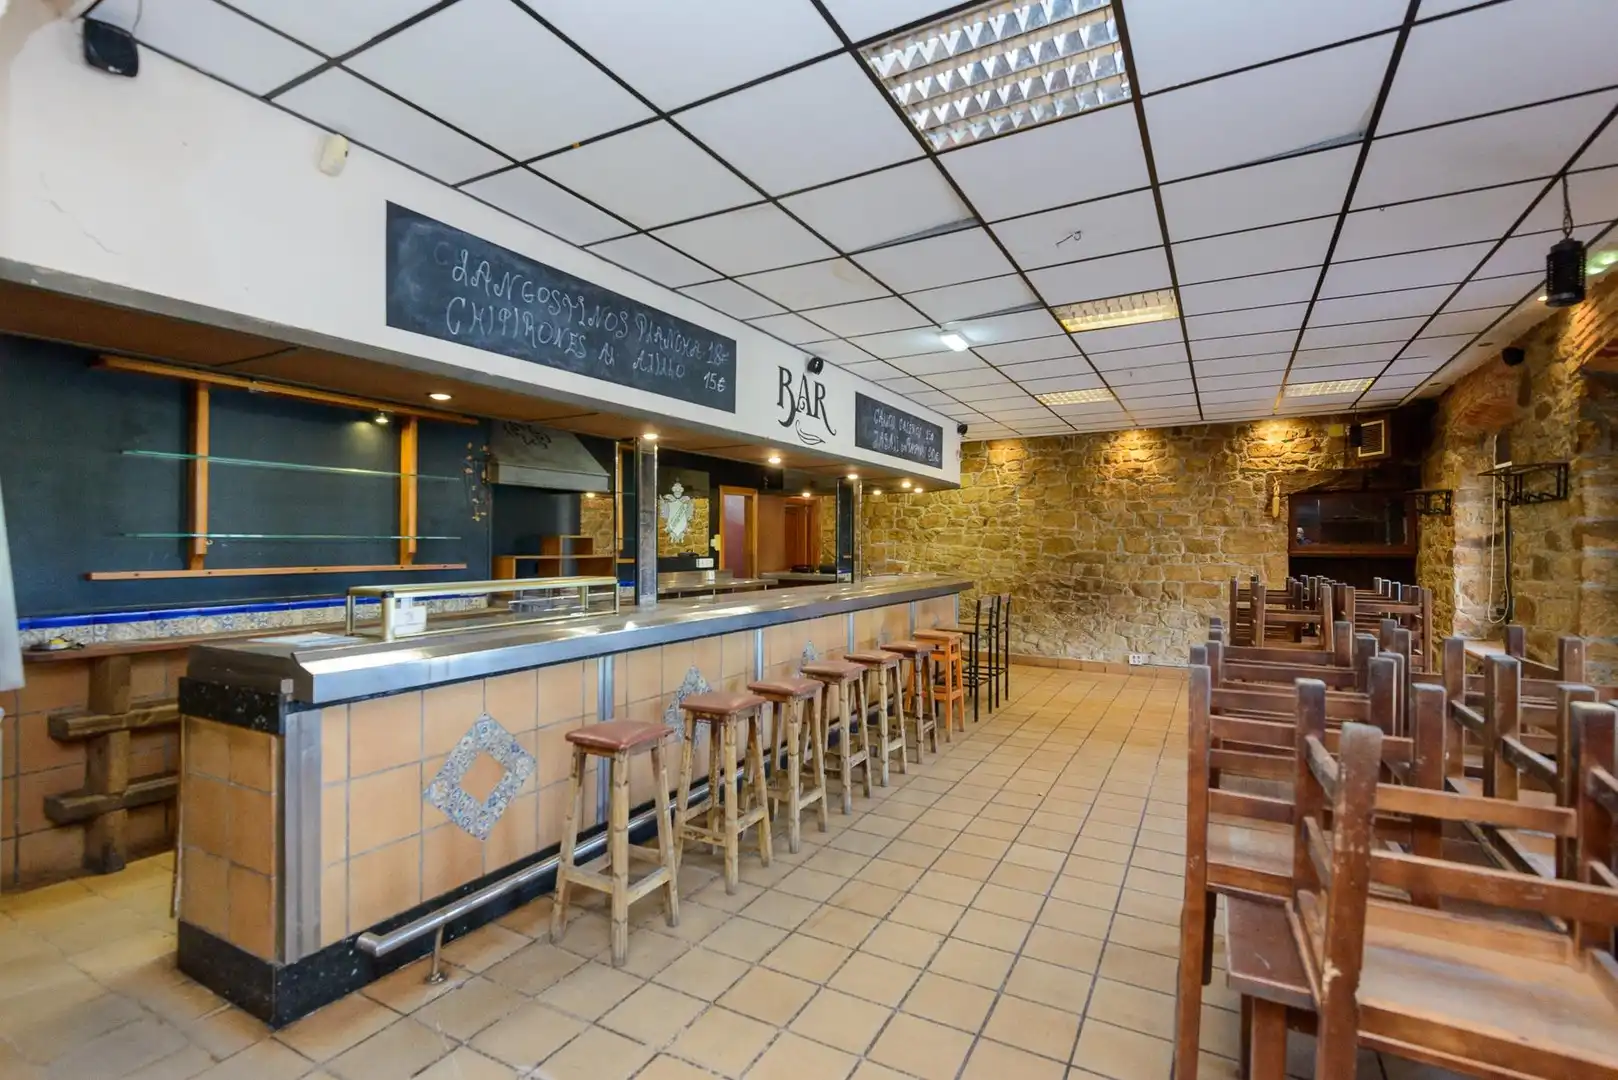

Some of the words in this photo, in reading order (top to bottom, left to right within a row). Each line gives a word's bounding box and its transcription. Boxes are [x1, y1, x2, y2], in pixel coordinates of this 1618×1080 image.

[452, 249, 628, 338] LANGOSTINOS
[446, 297, 587, 359] CHIPIRONES
[703, 371, 726, 393] 15€
[776, 365, 837, 436] BAR
